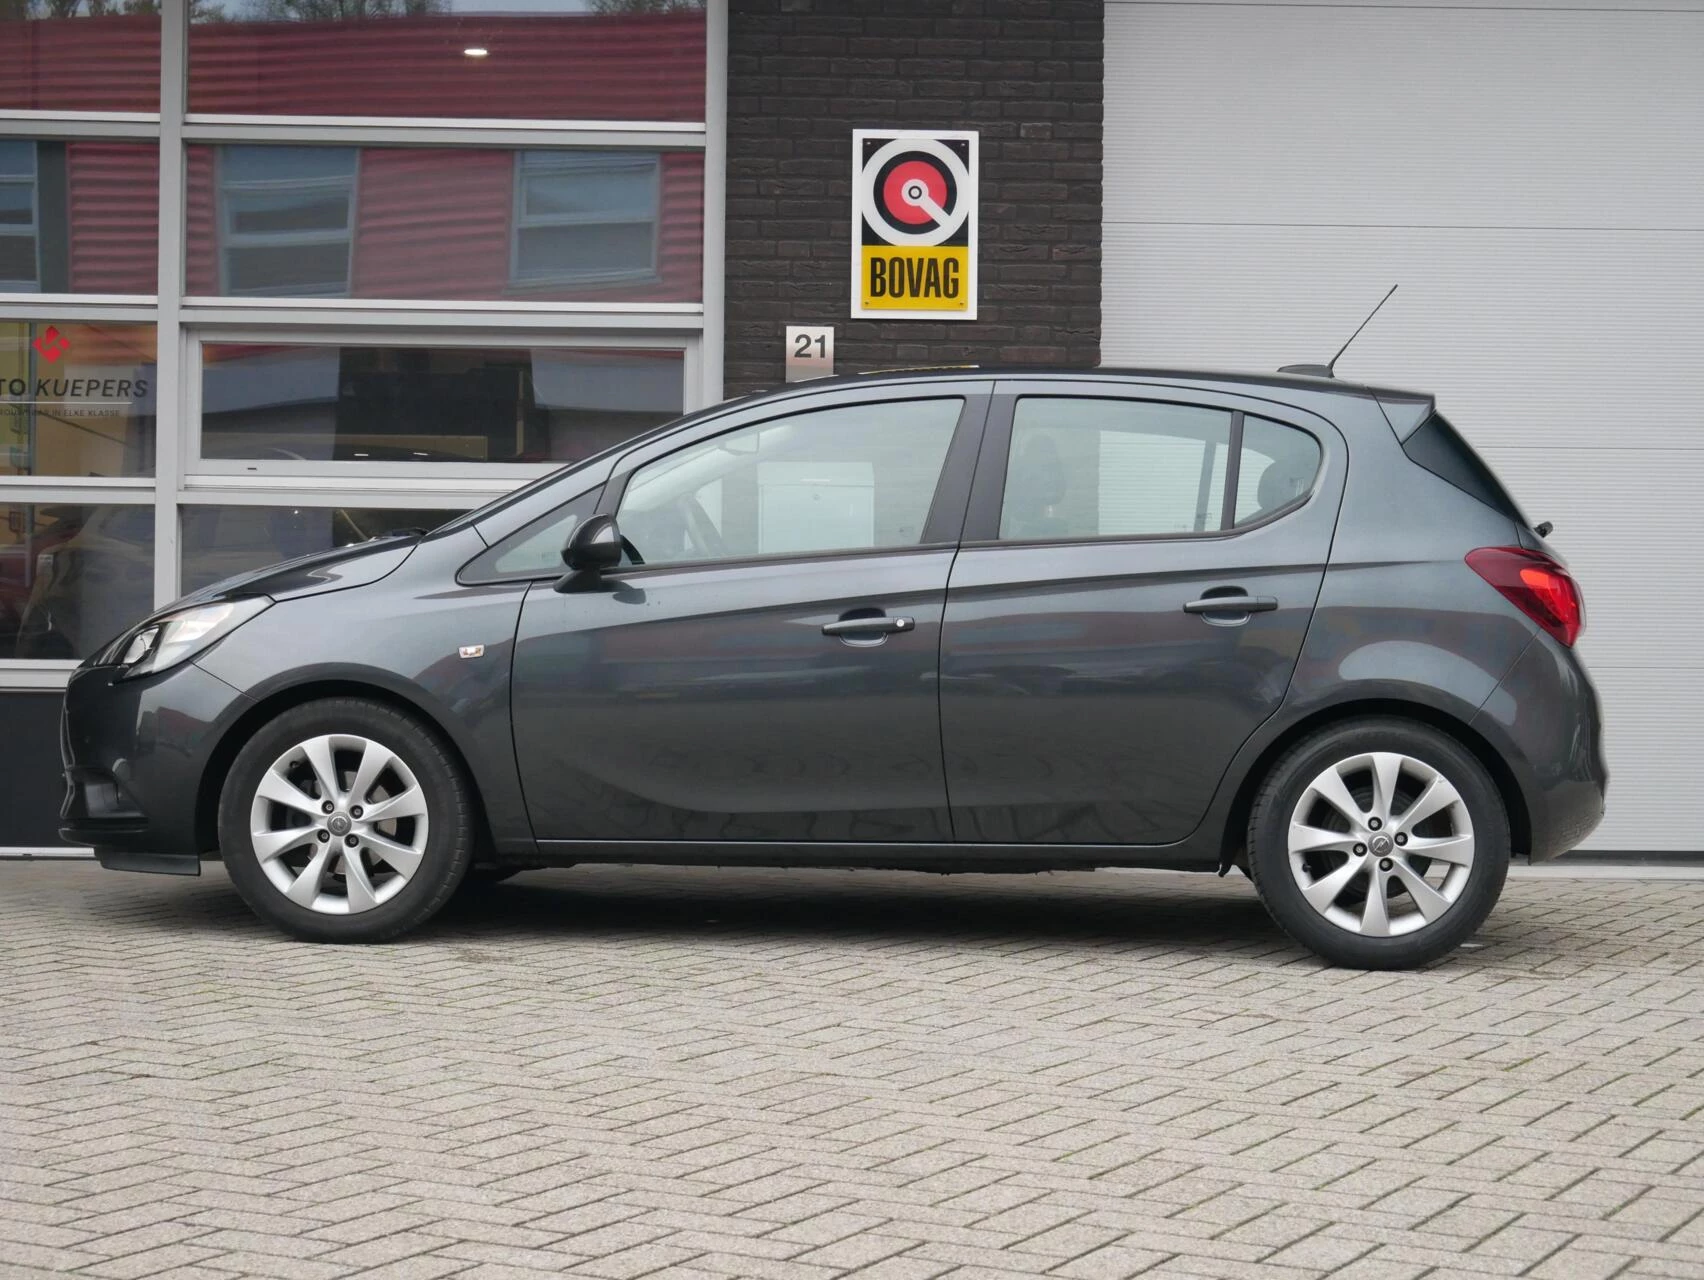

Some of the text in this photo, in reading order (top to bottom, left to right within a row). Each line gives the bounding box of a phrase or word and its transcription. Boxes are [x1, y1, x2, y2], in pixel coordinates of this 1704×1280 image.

[870, 256, 959, 298] BOVAG
[794, 334, 826, 358] 21
[36, 379, 149, 397] KUEPERS
[88, 409, 120, 417] KLASSE
